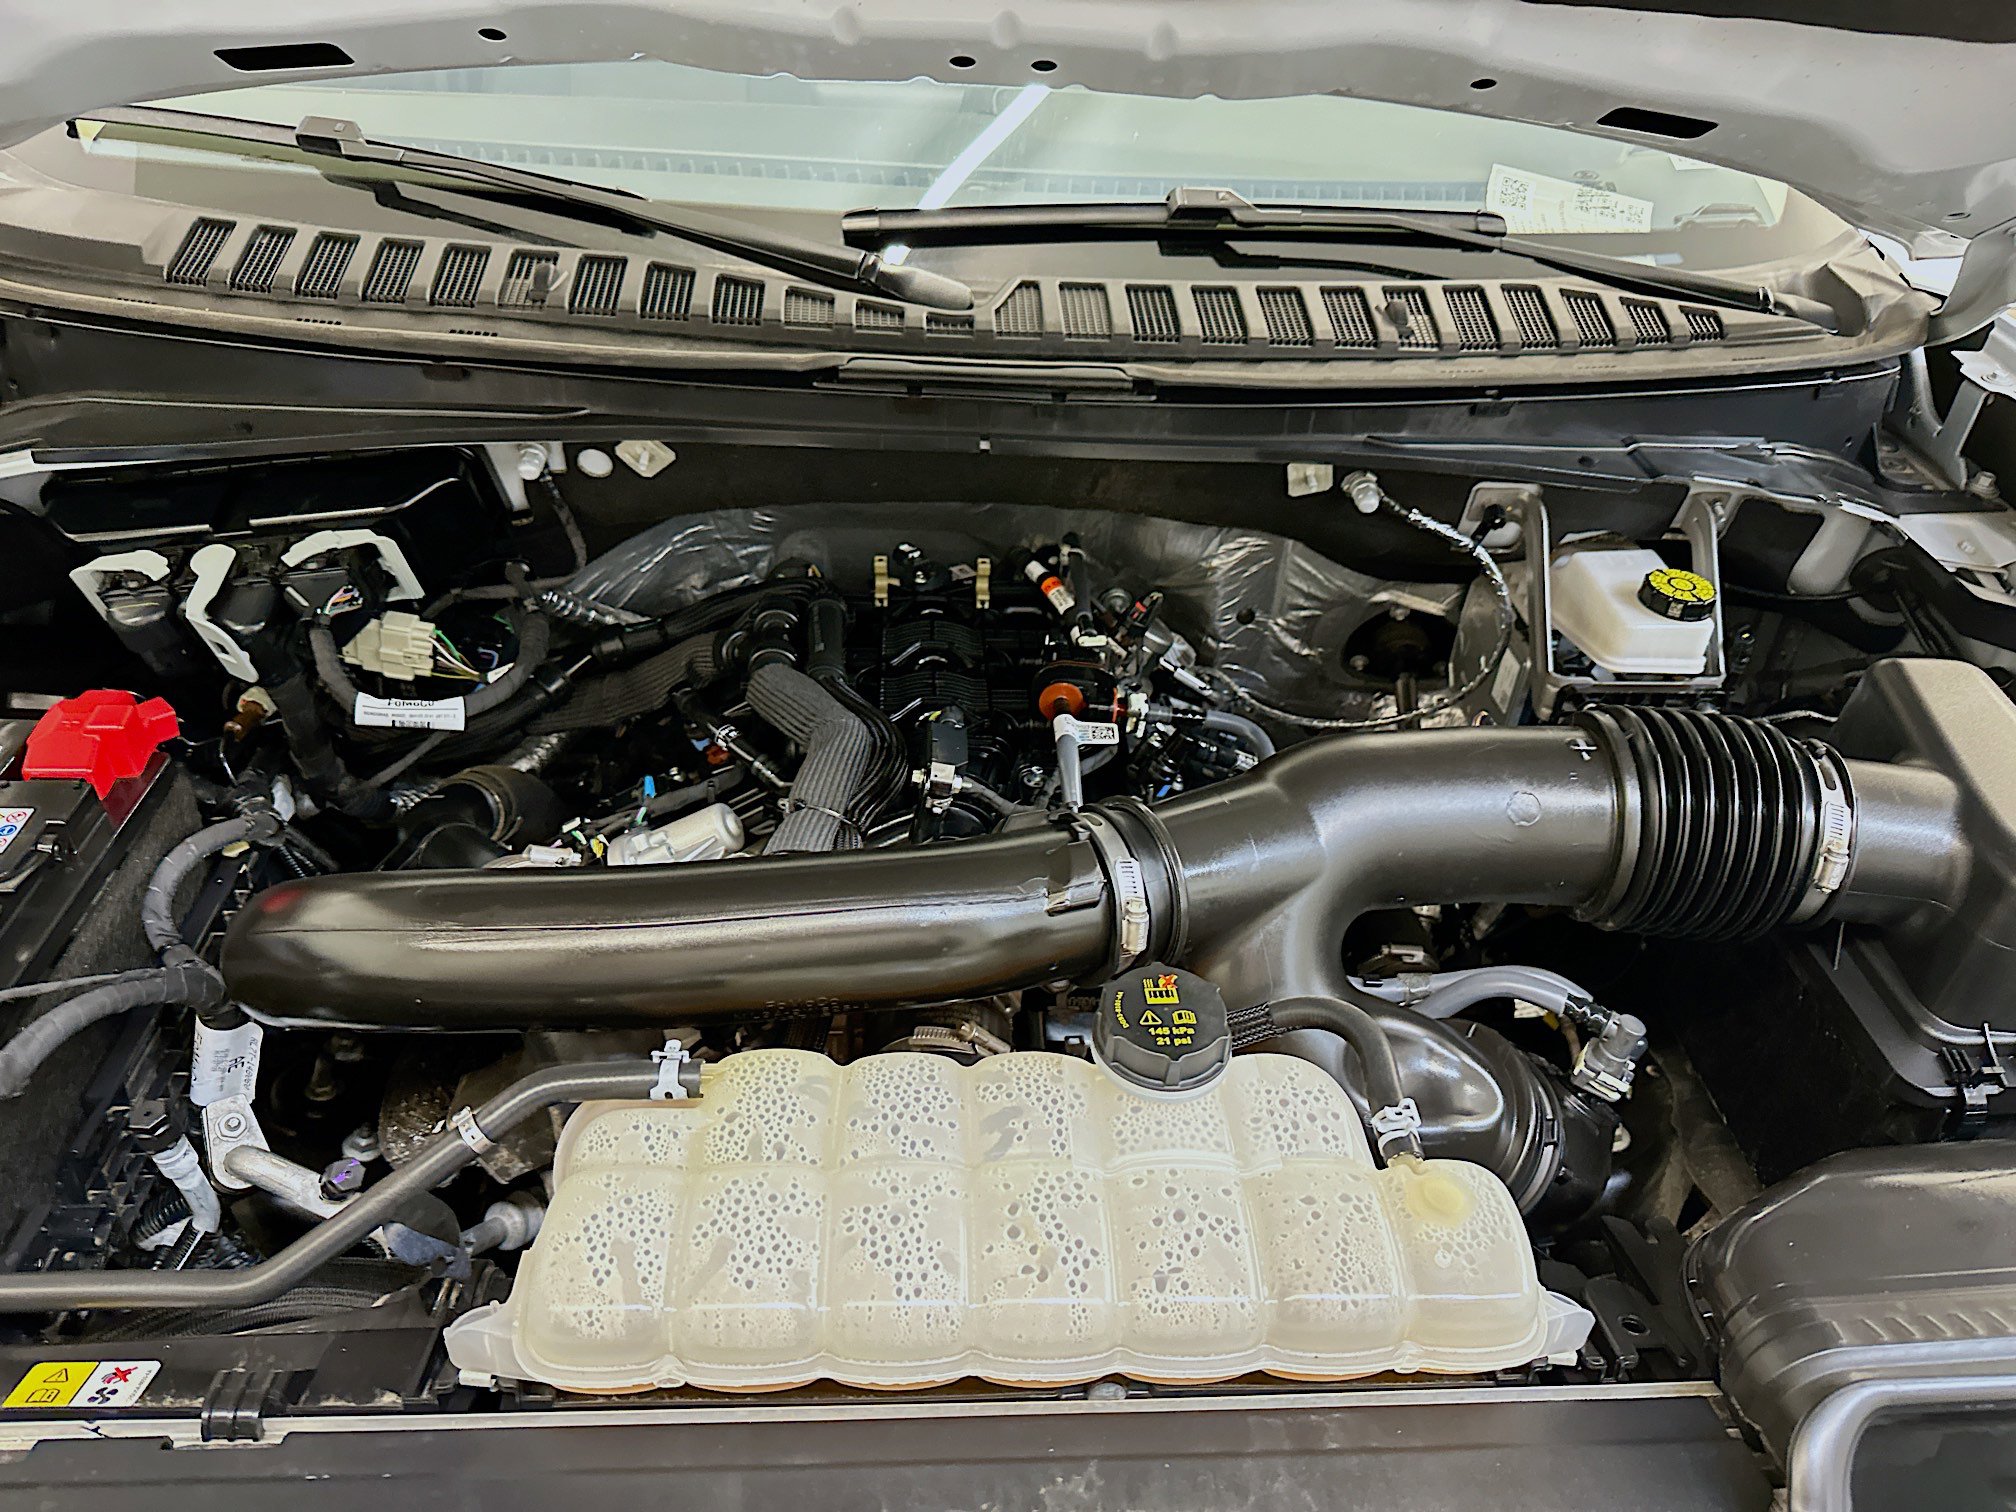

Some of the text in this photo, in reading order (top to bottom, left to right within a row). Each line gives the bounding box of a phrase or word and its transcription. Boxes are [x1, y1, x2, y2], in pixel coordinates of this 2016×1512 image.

[1148, 1027, 1195, 1036] 145 kPa
[1156, 1036, 1192, 1046] 21 psi
